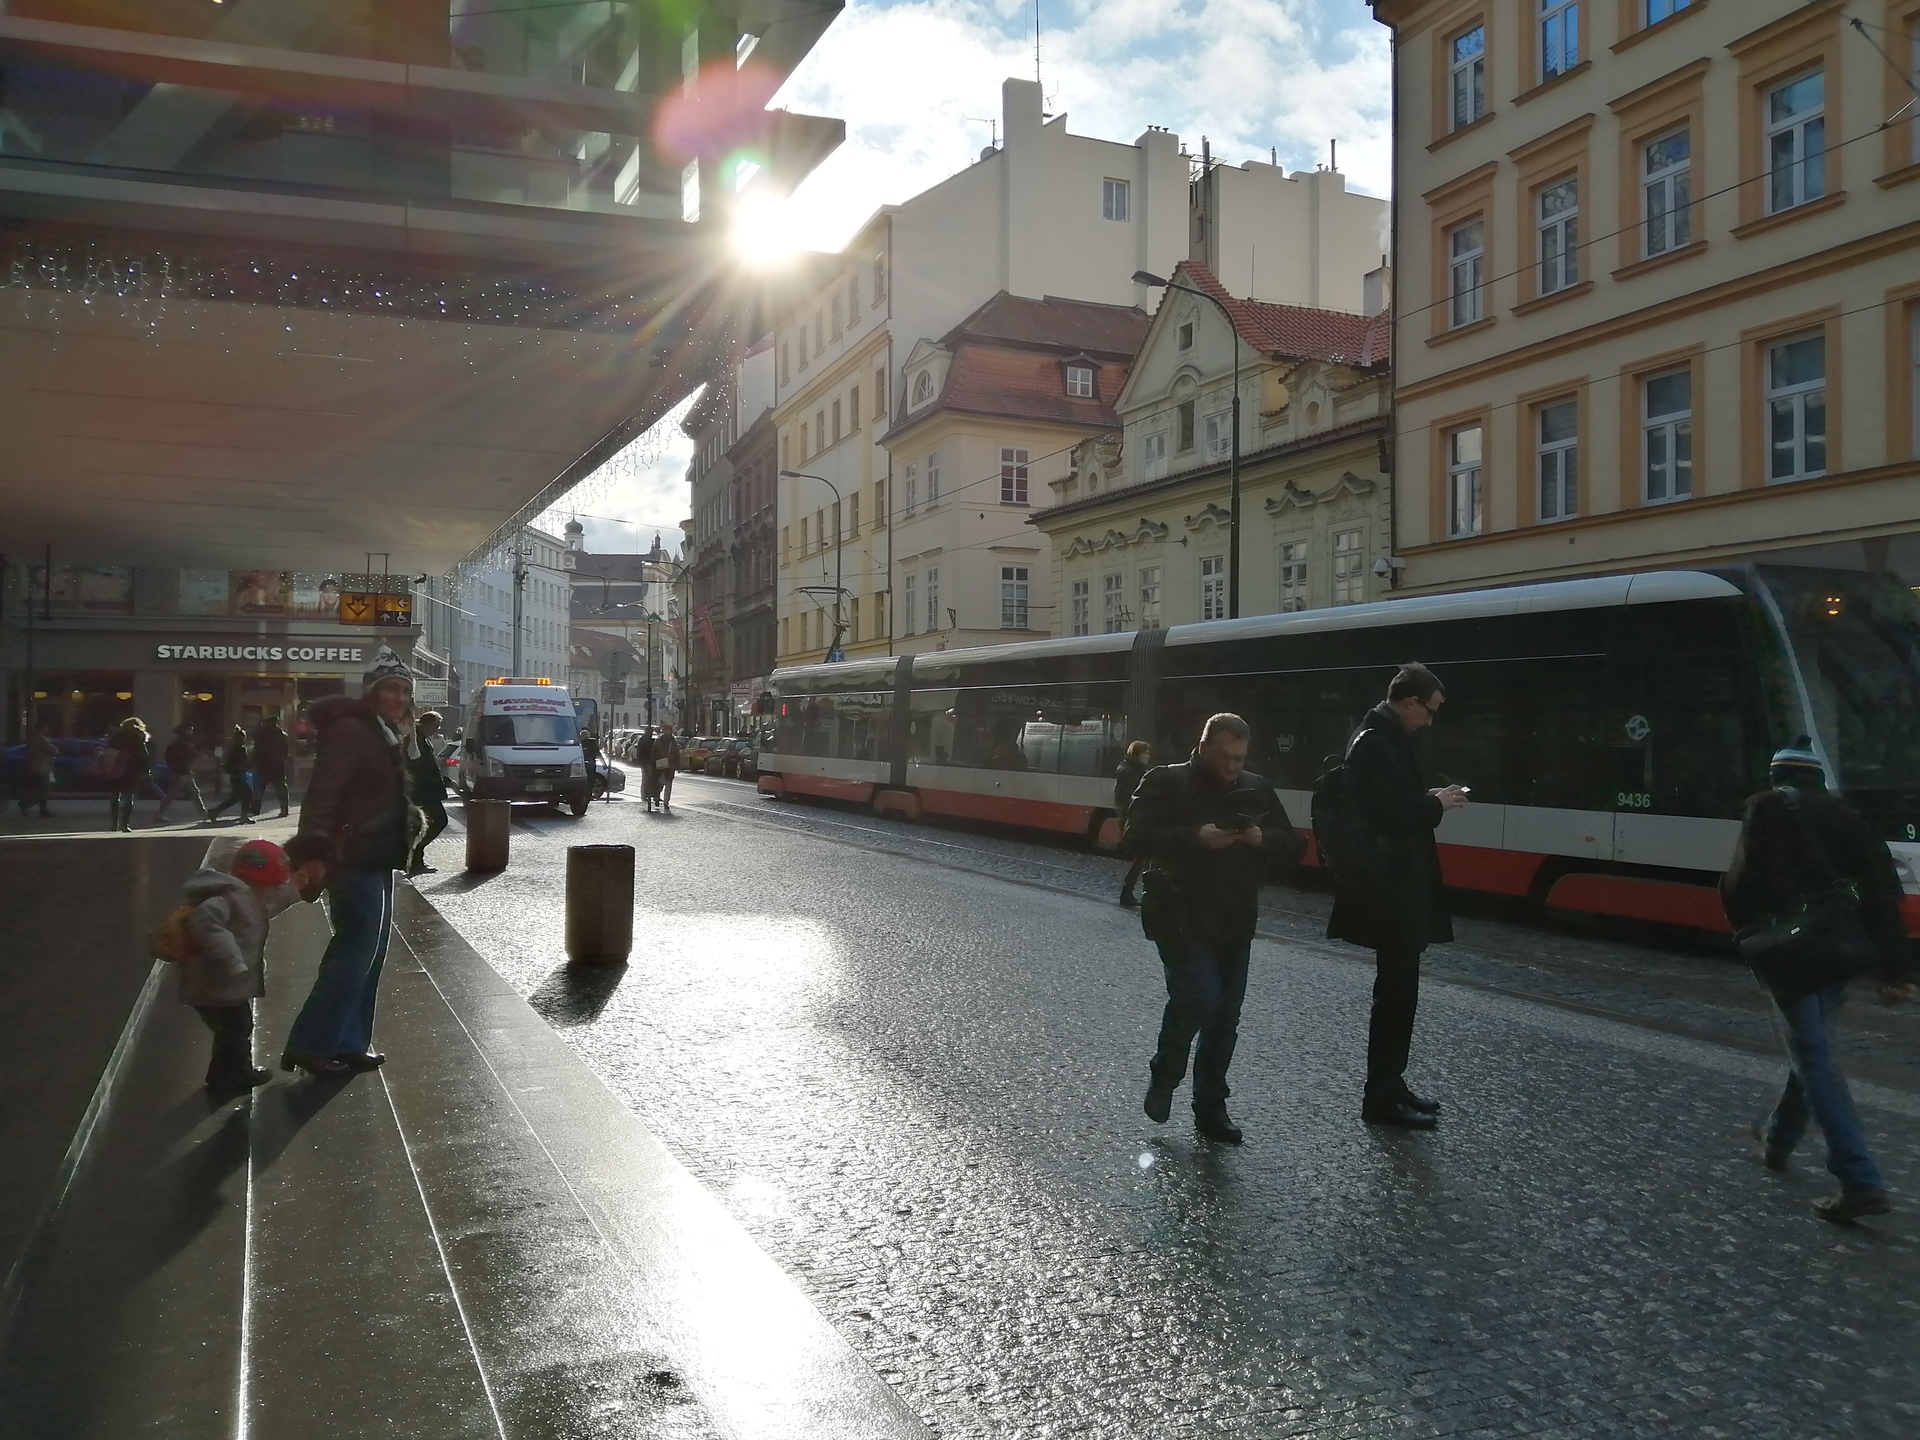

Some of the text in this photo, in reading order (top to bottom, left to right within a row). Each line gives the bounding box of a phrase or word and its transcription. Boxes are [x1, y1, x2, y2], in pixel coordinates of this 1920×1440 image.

[157, 644, 362, 661] STARBUCKS COFFEE
[1617, 792, 1651, 808] 9436
